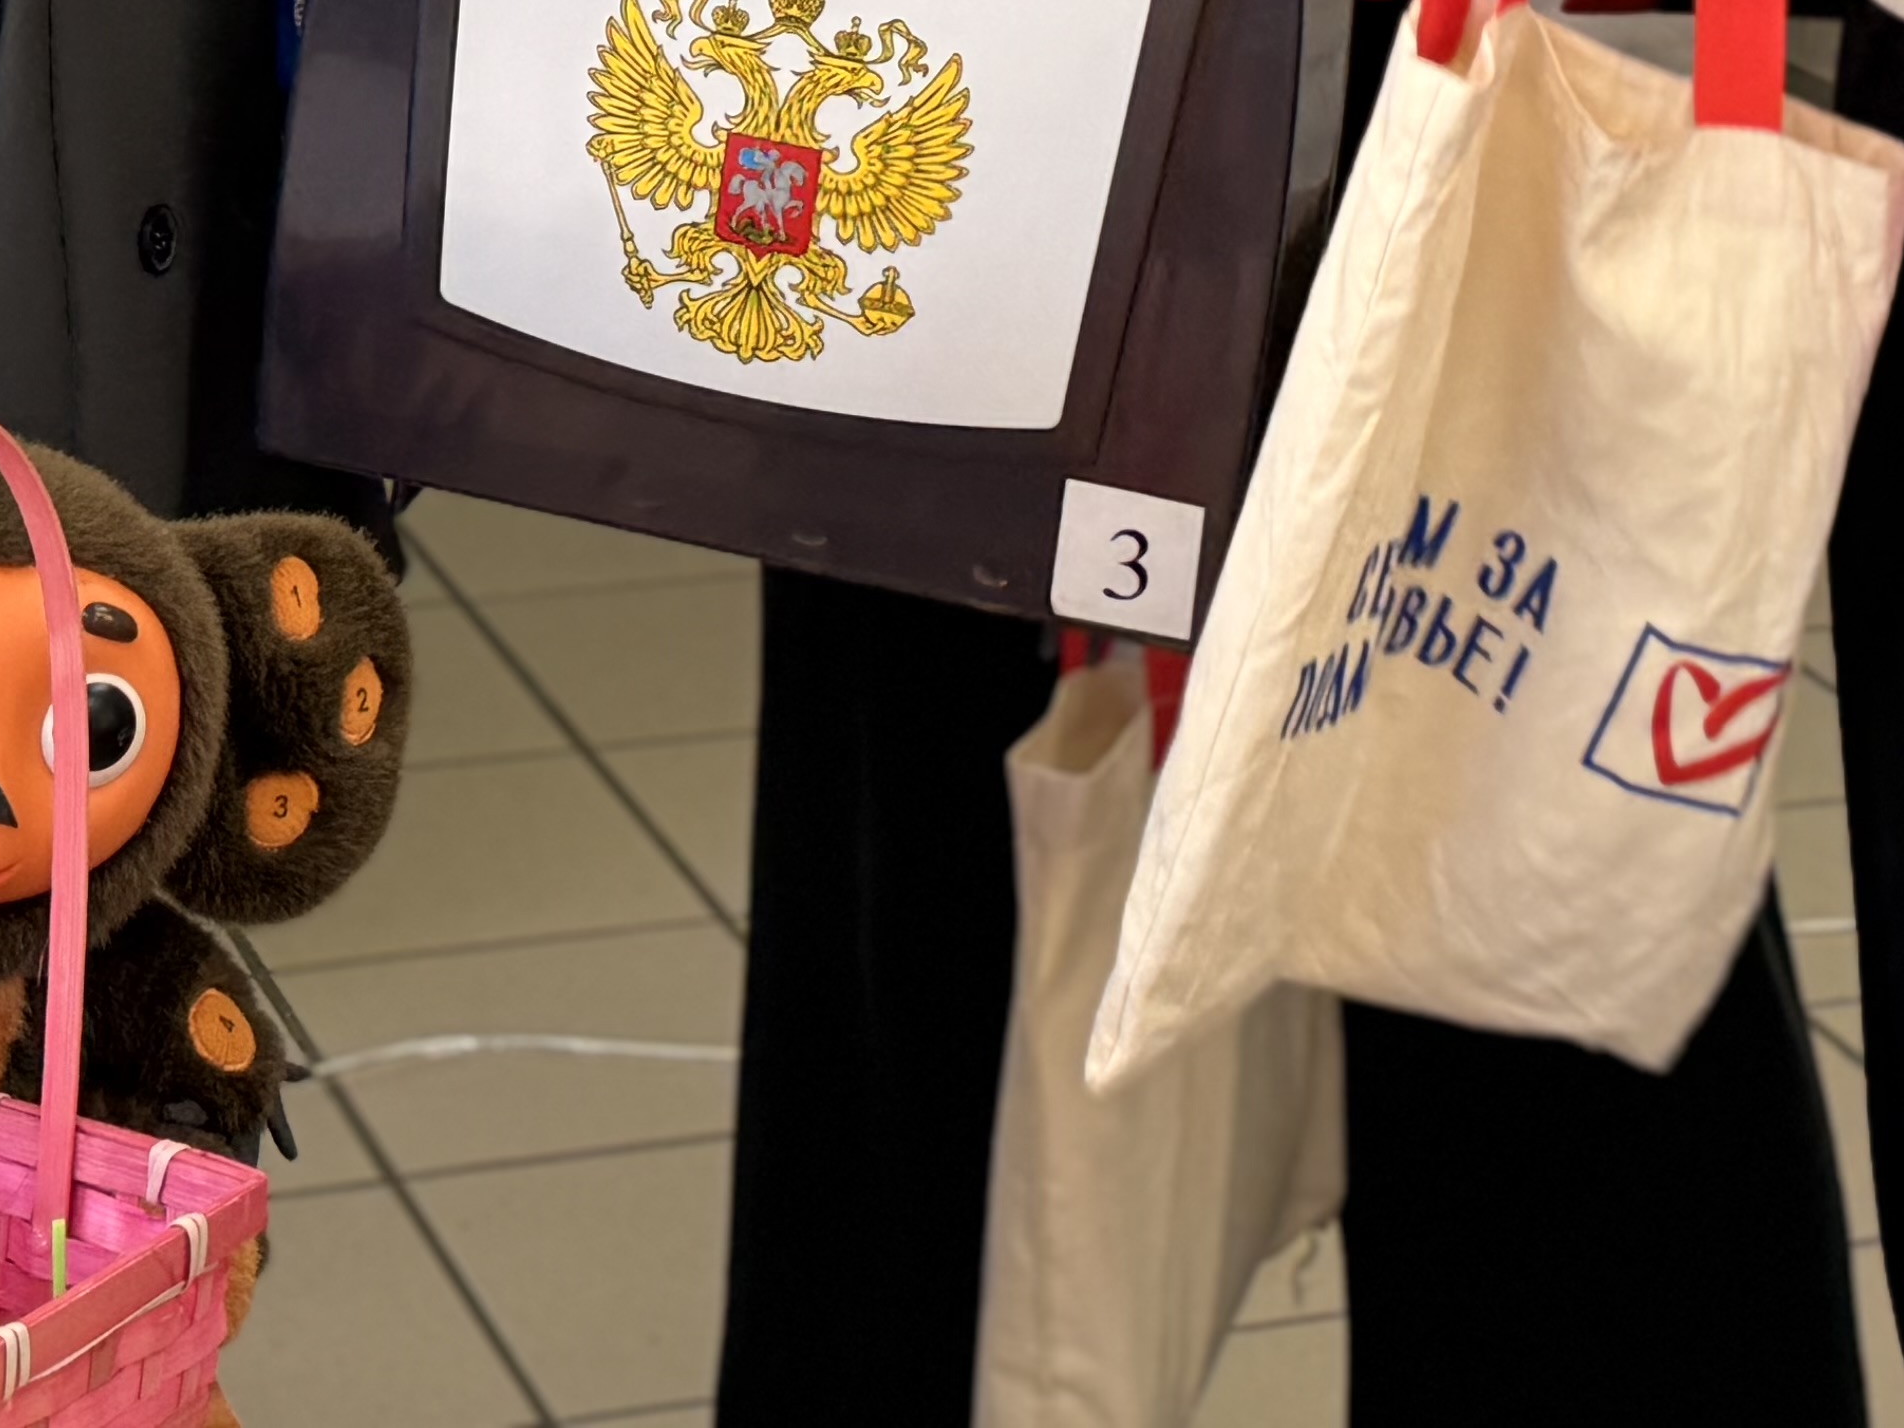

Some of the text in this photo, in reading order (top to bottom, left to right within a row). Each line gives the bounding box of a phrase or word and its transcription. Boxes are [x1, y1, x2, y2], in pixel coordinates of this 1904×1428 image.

[1104, 529, 1150, 601] 3
[1477, 530, 1557, 634] ЗА
[290, 585, 302, 609] 1
[356, 688, 369, 713] 2
[273, 795, 289, 819] 3
[217, 1014, 236, 1035] 4
